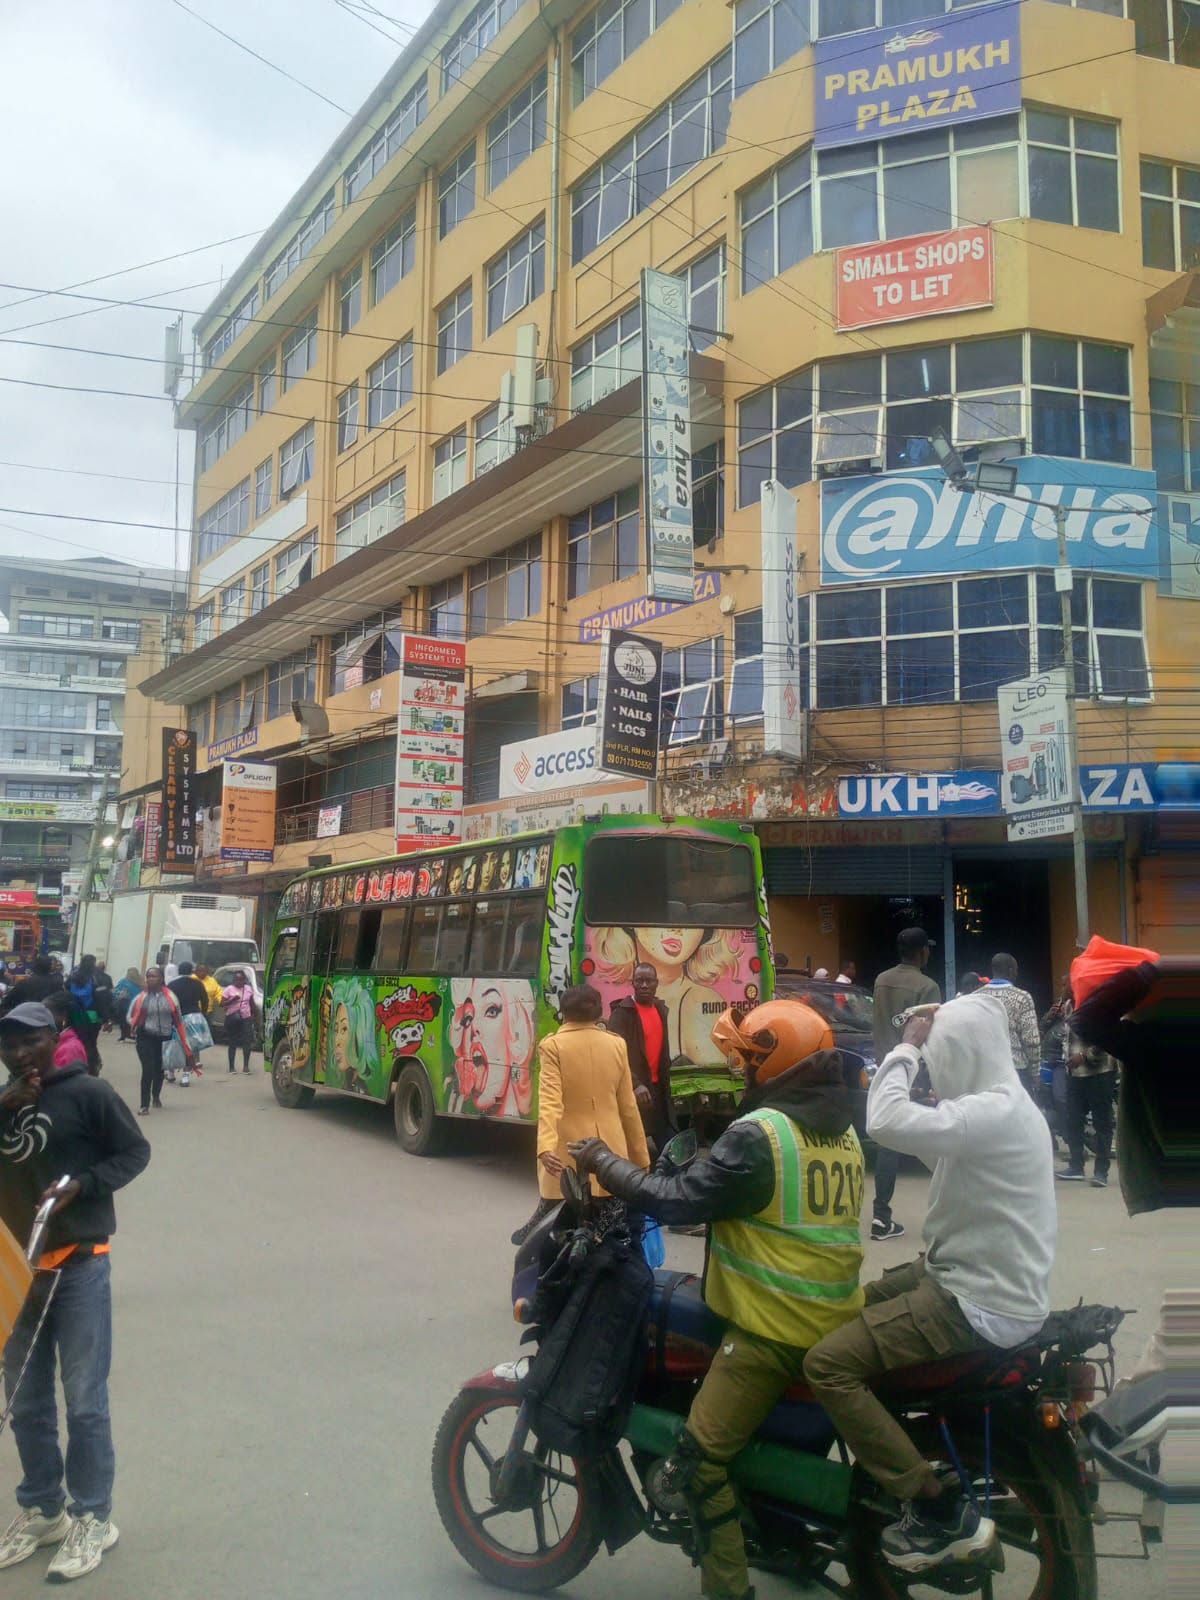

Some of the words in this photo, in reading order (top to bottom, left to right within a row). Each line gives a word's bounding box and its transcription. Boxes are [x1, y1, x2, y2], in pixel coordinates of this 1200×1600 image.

[824, 39, 1010, 99] PRAMUKH
[855, 85, 977, 132] PLAZA
[841, 251, 909, 283] SMALL
[915, 236, 985, 272] SHOPS
[873, 282, 903, 307] TO
[911, 273, 953, 301] LET
[583, 600, 656, 641] PRAMUKH
[783, 538, 796, 671] access
[409, 651, 445, 666] SYSTEMS
[446, 654, 462, 665] LTD
[414, 643, 457, 656] INFORMED
[620, 687, 648, 704] HAIR
[1017, 684, 1047, 703] LEO
[618, 722, 647, 738] LOCS
[619, 705, 653, 723] NAILS
[534, 745, 596, 778] access
[180, 753, 191, 841] SYSTEMS
[176, 844, 194, 856] LTD
